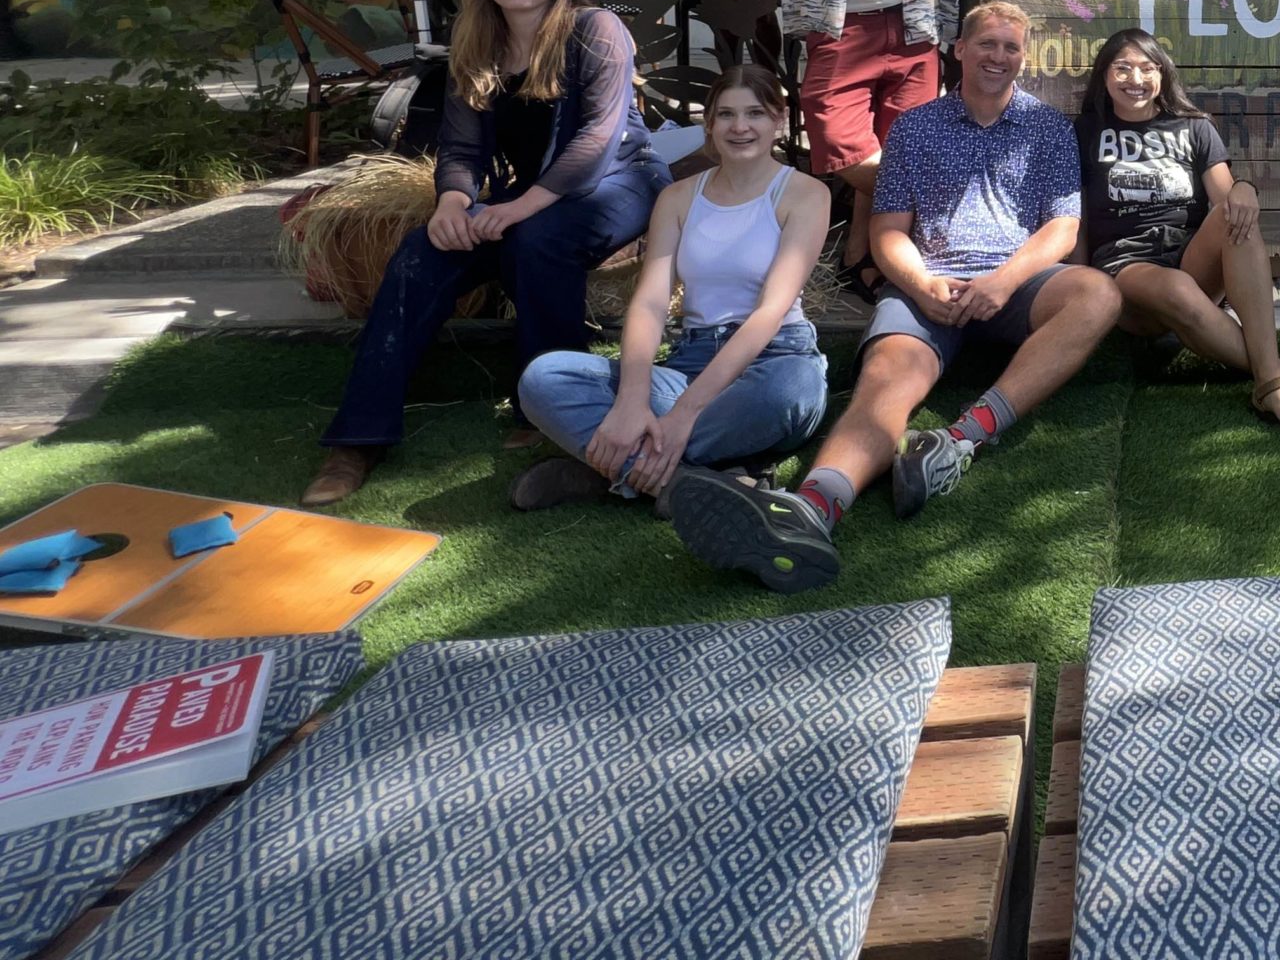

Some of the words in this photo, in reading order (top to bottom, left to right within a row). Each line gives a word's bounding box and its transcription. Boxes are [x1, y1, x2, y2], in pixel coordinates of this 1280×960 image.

[1098, 128, 1194, 162] BDSM
[109, 682, 172, 760] PARADISE
[170, 664, 241, 728] PAVED
[11, 722, 46, 746] THE
[26, 717, 76, 772] EXPLAINS
[57, 723, 101, 772] PARKING
